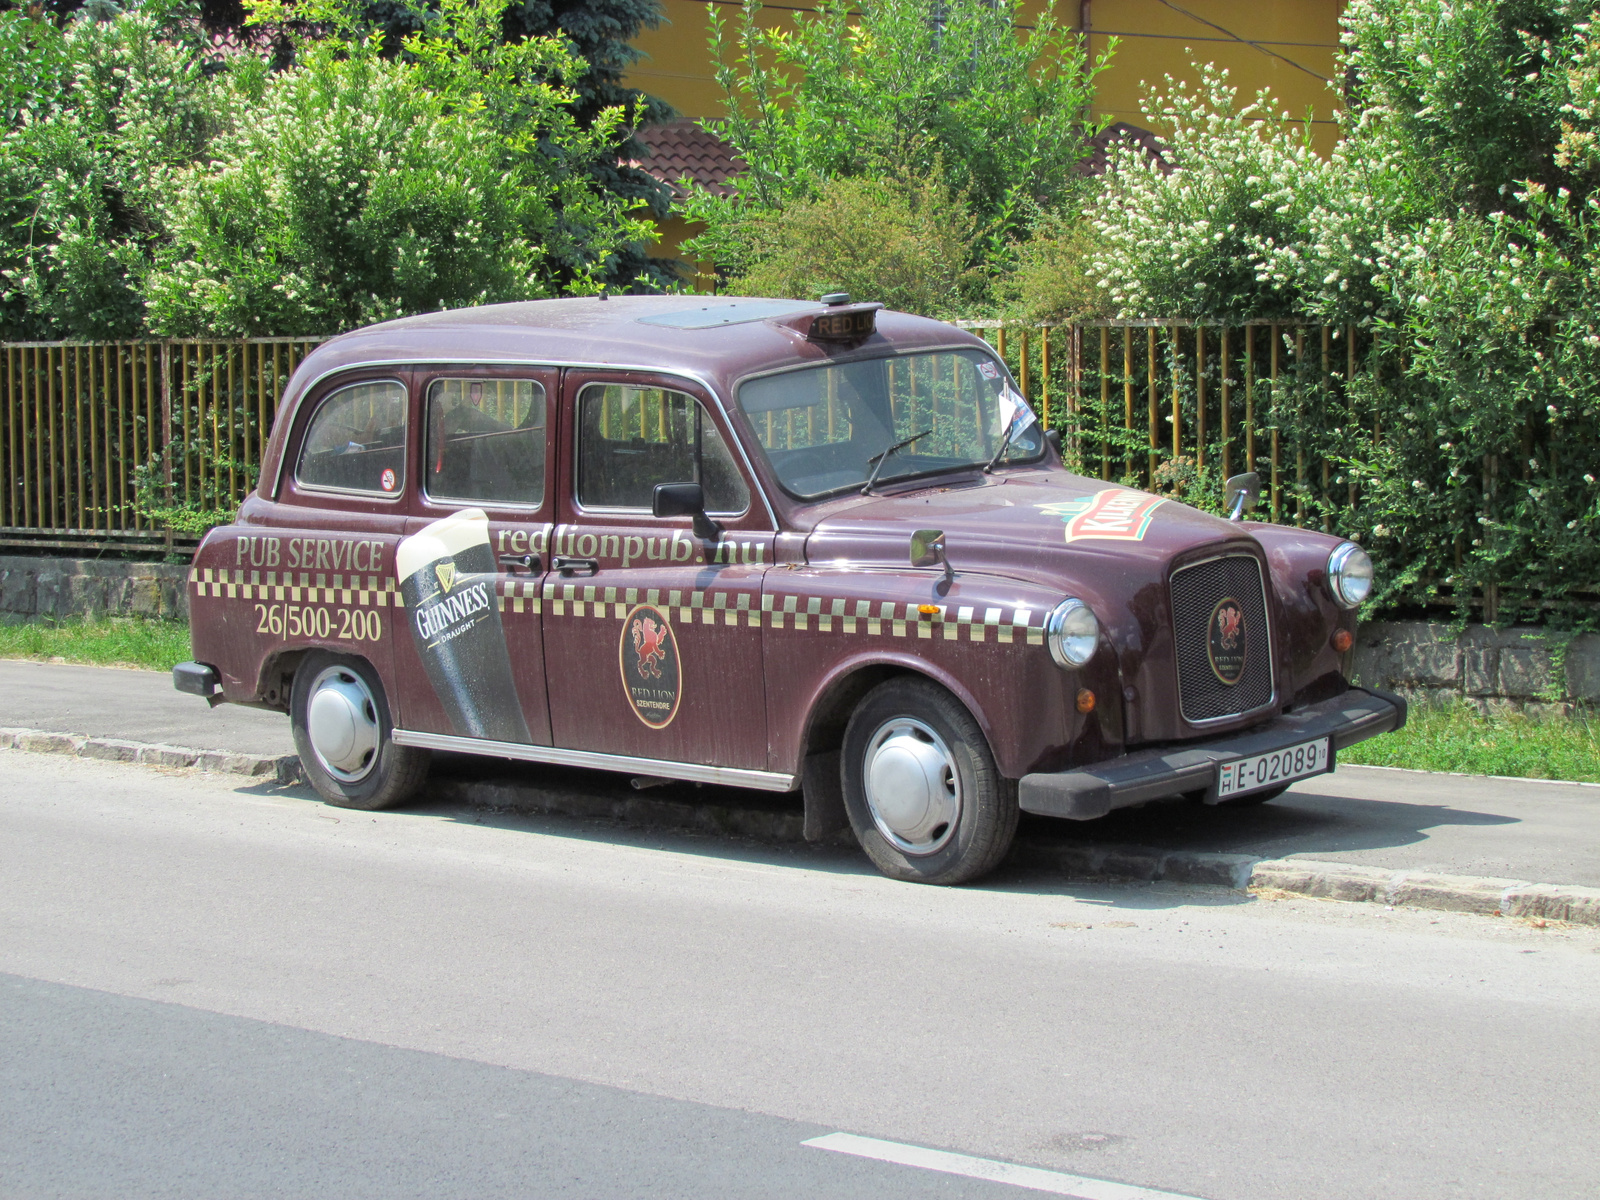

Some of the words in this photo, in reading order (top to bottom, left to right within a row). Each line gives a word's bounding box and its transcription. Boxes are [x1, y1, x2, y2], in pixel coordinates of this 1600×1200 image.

[818, 316, 853, 334] RED
[236, 536, 281, 567] PUB
[287, 538, 385, 572] SERVICE
[254, 603, 382, 642] 26/500-200
[416, 582, 489, 640] GUINNESS
[440, 619, 476, 643] DRAUGHT
[631, 687, 651, 698] RED
[653, 689, 676, 701] LION
[636, 699, 671, 710] SZENTENDRE
[1221, 779, 1232, 793] H
[1237, 744, 1317, 789] E-02089
